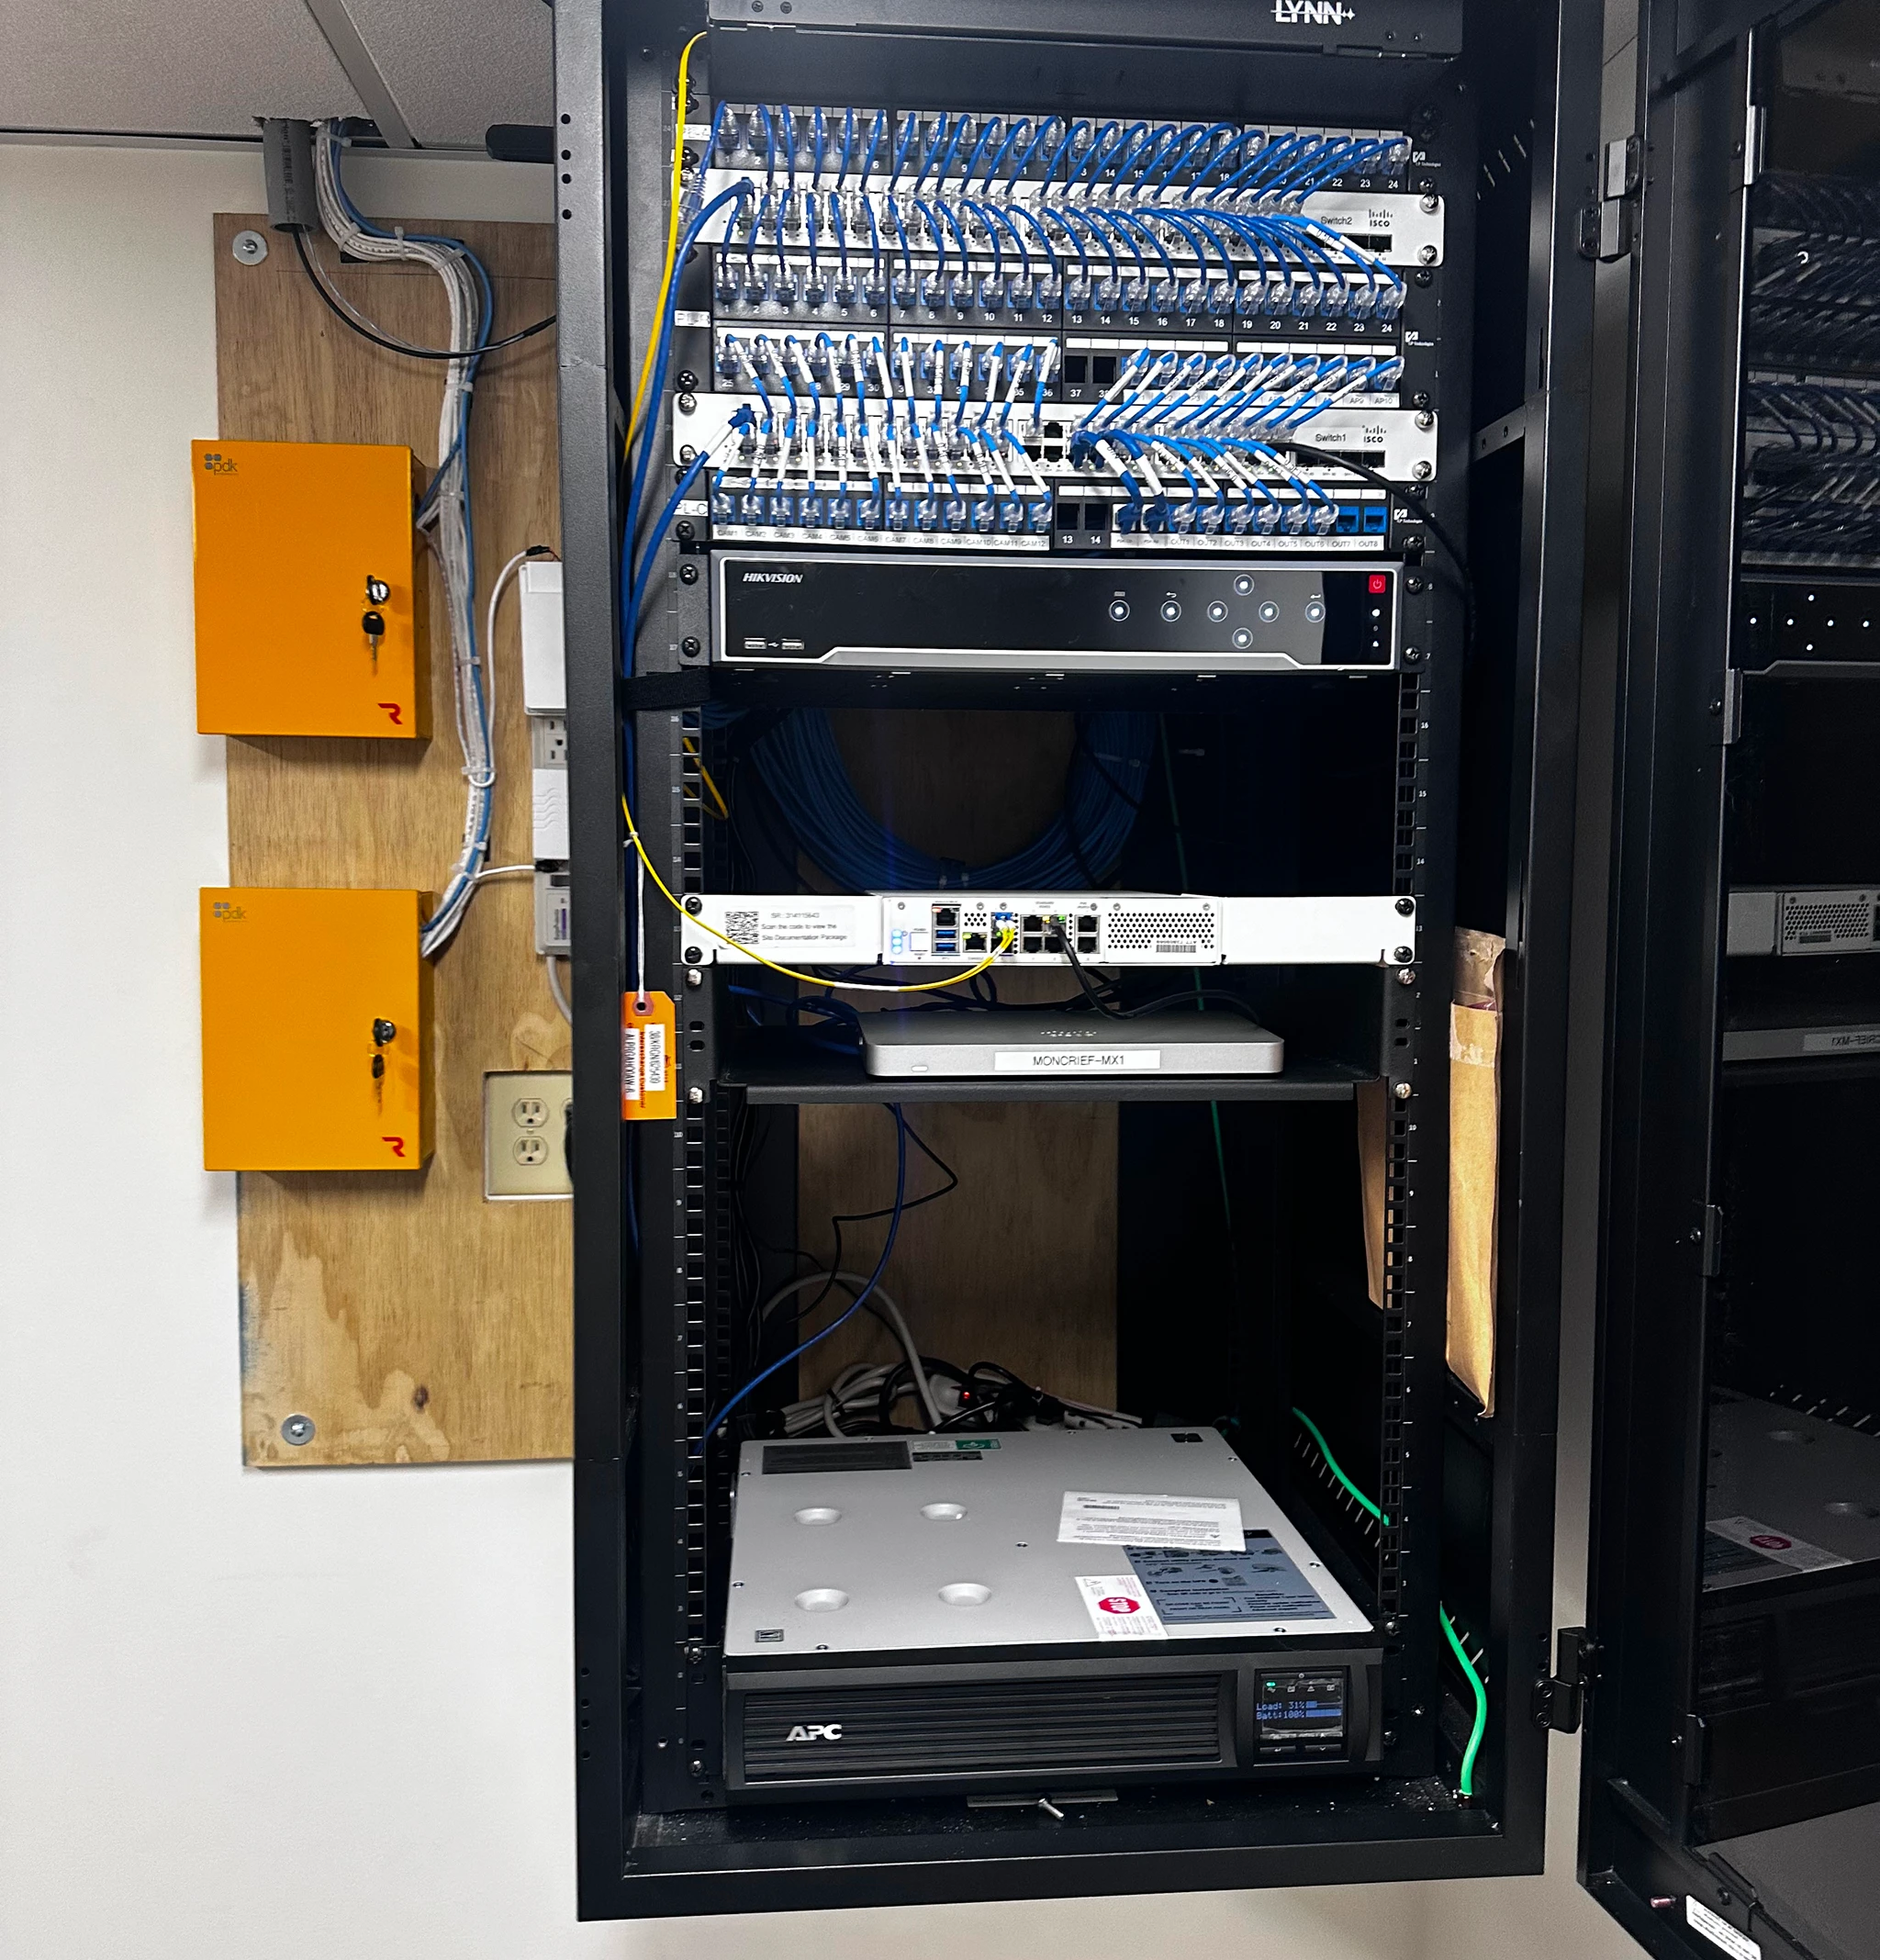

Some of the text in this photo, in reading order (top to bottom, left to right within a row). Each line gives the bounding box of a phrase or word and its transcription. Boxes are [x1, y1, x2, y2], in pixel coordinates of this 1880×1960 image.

[1275, 0, 1342, 25] LYNN
[755, 156, 761, 164] 2
[902, 162, 909, 170] 7
[933, 163, 939, 172] 8
[961, 164, 968, 173] 9
[1104, 168, 1115, 177] 14
[1332, 178, 1343, 187] 22
[1360, 179, 1371, 188] 23
[1388, 180, 1399, 189] 24
[1320, 215, 1353, 226] Switch2
[724, 305, 1393, 333] 1 2 3 4 5 6 7 8 9 10 11 12 13 14 15 16 17 18 19 20 21 22 23 24
[722, 379, 733, 387] 25
[1042, 388, 1053, 397] 36
[1069, 388, 1082, 398] 37
[1315, 433, 1347, 442] Switch1
[214, 459, 238, 476] pdk
[1062, 535, 1102, 544] 13 14
[1331, 540, 1351, 548] OUT7
[1359, 540, 1379, 548] OUT8
[742, 573, 803, 584] HIKVISION
[222, 907, 247, 923] pdk
[1033, 1055, 1125, 1066] MONCRIEF-MX1
[1256, 1701, 1305, 1711] Load: 31%
[786, 1723, 843, 1742] APC
